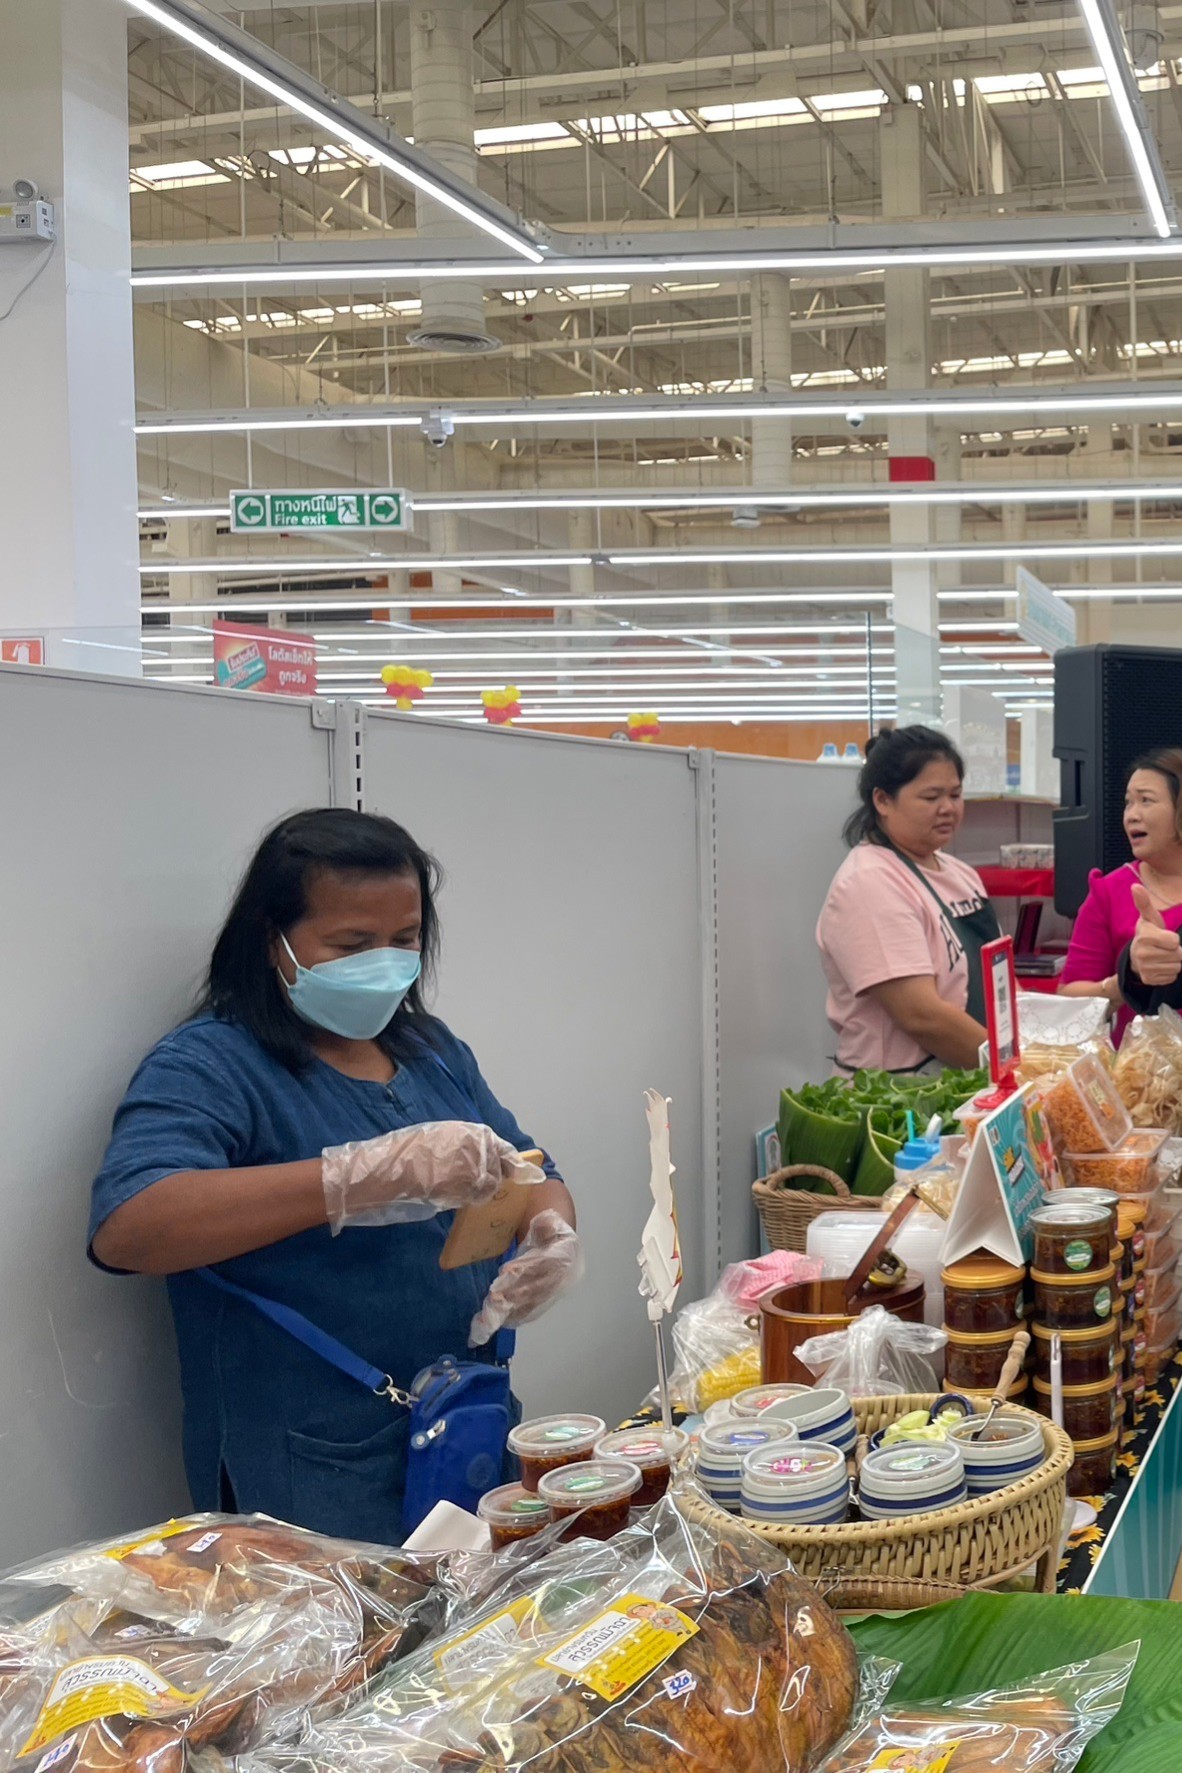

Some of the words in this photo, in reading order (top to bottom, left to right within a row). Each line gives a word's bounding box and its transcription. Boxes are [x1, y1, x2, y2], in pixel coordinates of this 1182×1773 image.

[275, 495, 337, 513] ทางหนีไฟ
[275, 513, 298, 525] Fire
[301, 513, 327, 525] exit
